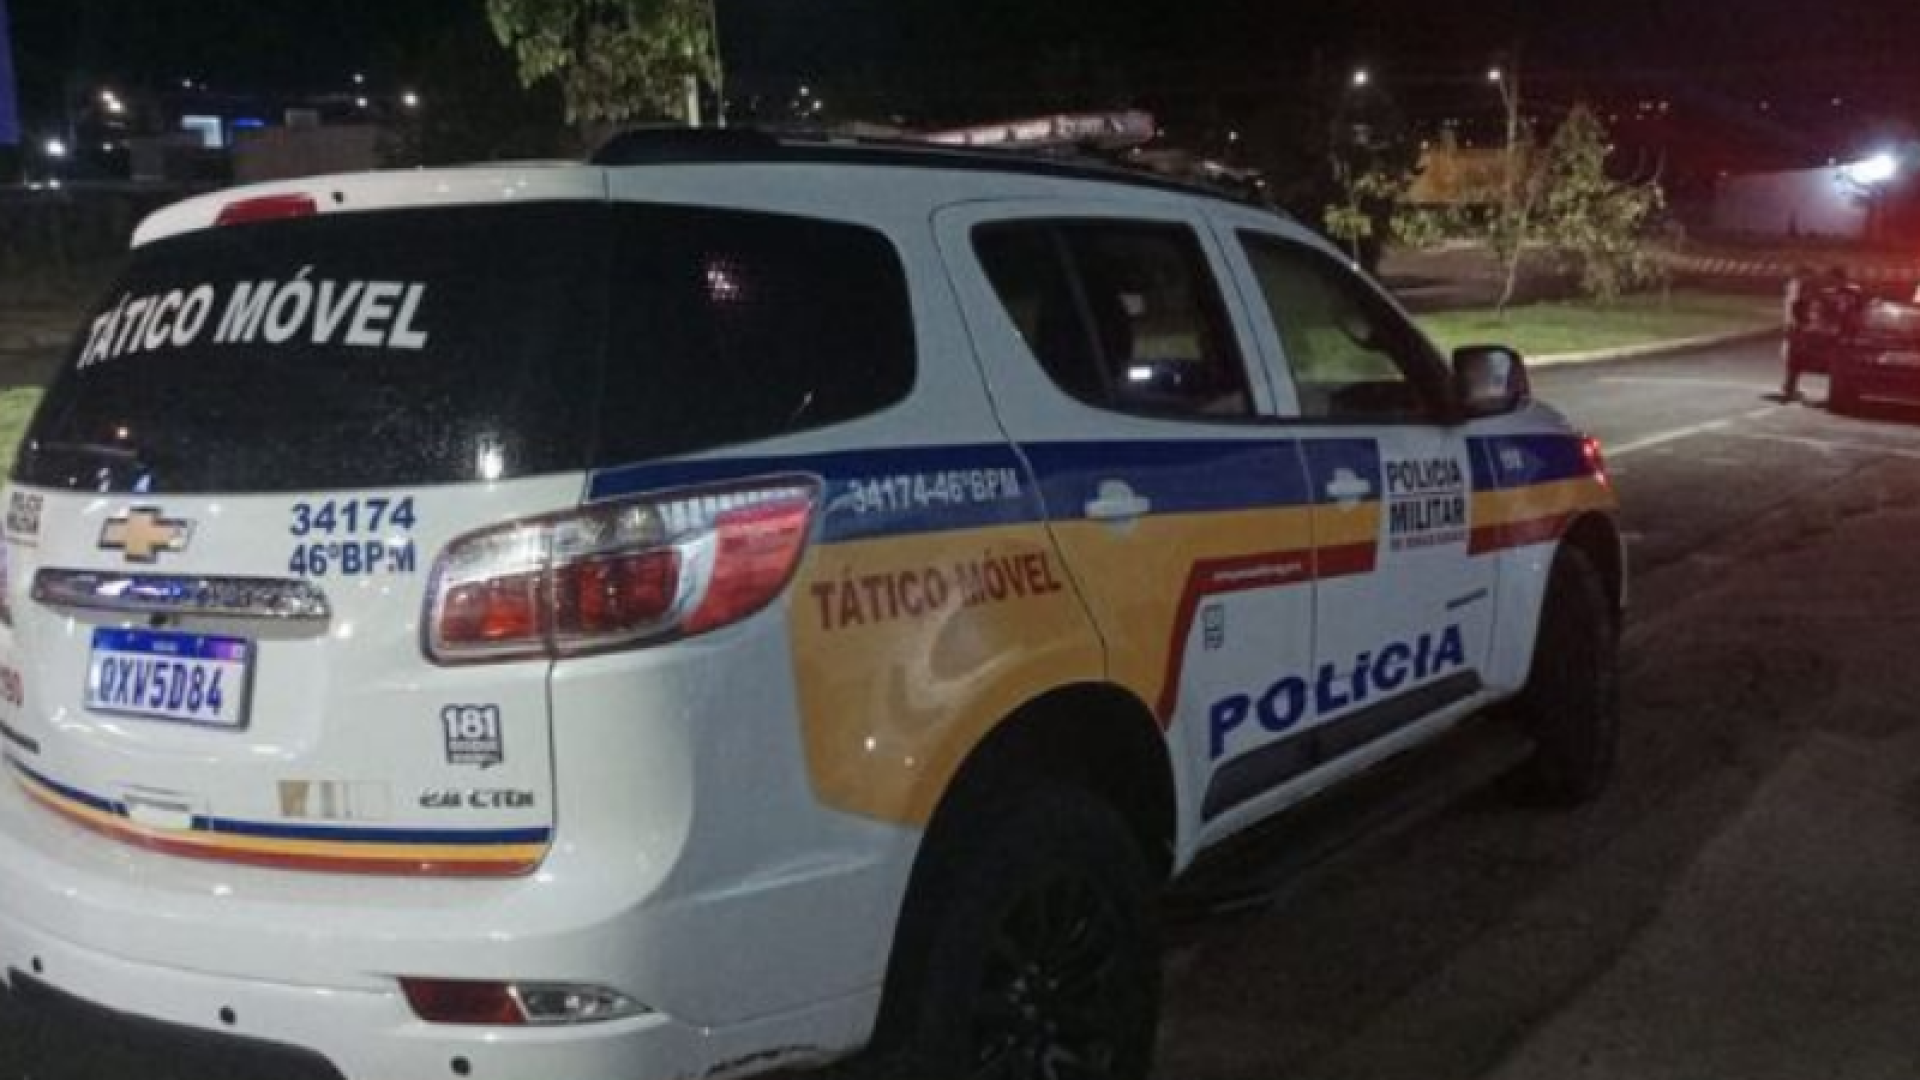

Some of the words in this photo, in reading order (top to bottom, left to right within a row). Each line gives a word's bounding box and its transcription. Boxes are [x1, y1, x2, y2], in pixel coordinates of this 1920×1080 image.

[77, 285, 215, 369] TÁTICO
[214, 265, 428, 348] MÓVEL
[290, 496, 416, 535] 34174
[1390, 498, 1464, 534] MILITAR
[811, 564, 948, 629] TÁTICO
[954, 548, 1062, 607] MÓVEL
[444, 707, 498, 739] 181
